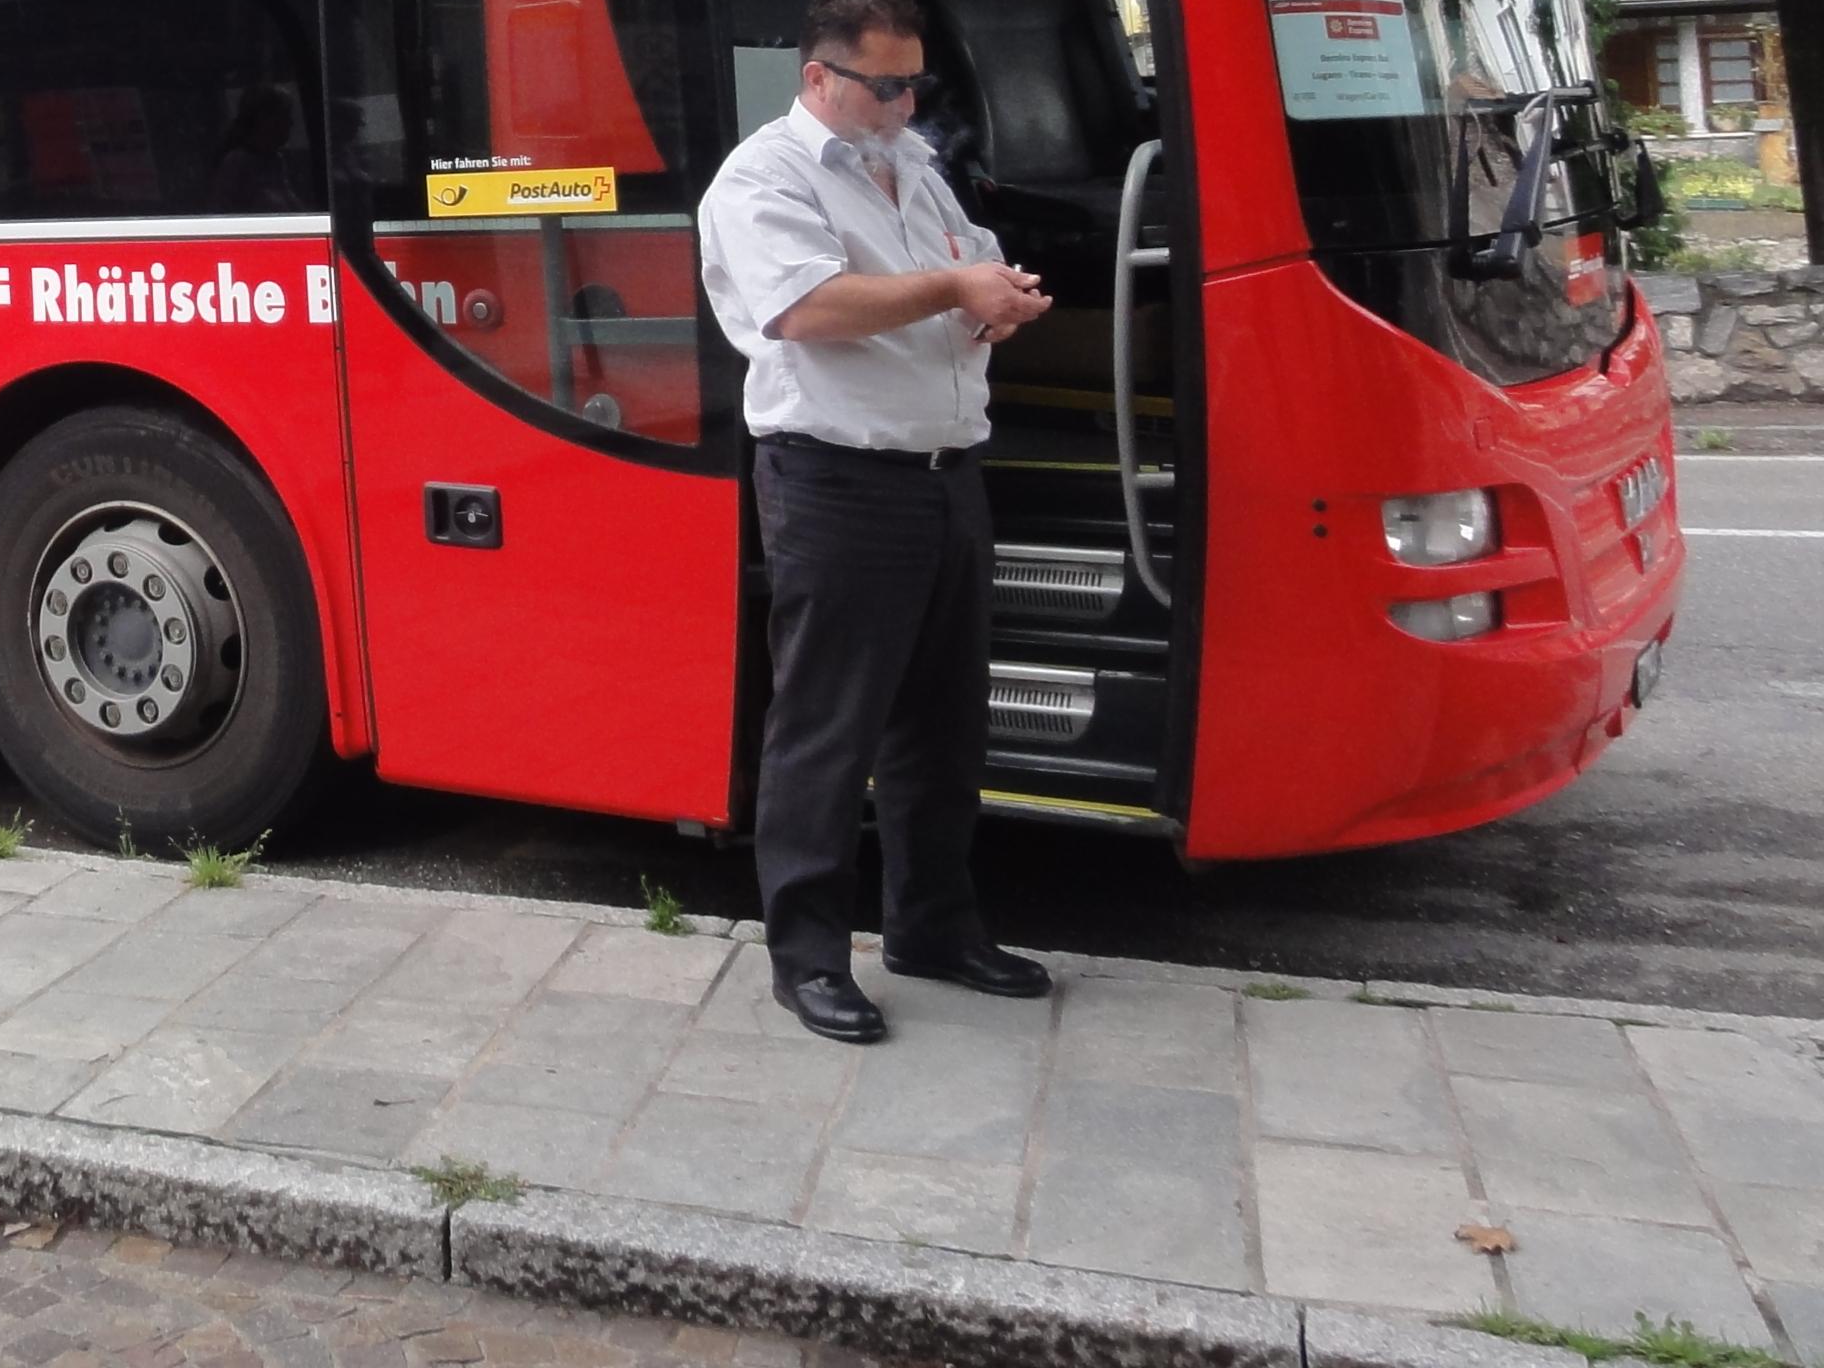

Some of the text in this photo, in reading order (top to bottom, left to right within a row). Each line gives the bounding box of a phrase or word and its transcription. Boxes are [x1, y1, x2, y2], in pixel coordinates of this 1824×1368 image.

[430, 155, 532, 170] Hier fahren Sie mit:
[510, 181, 592, 199] PostAuto
[31, 260, 457, 324] Rhätische Bn
